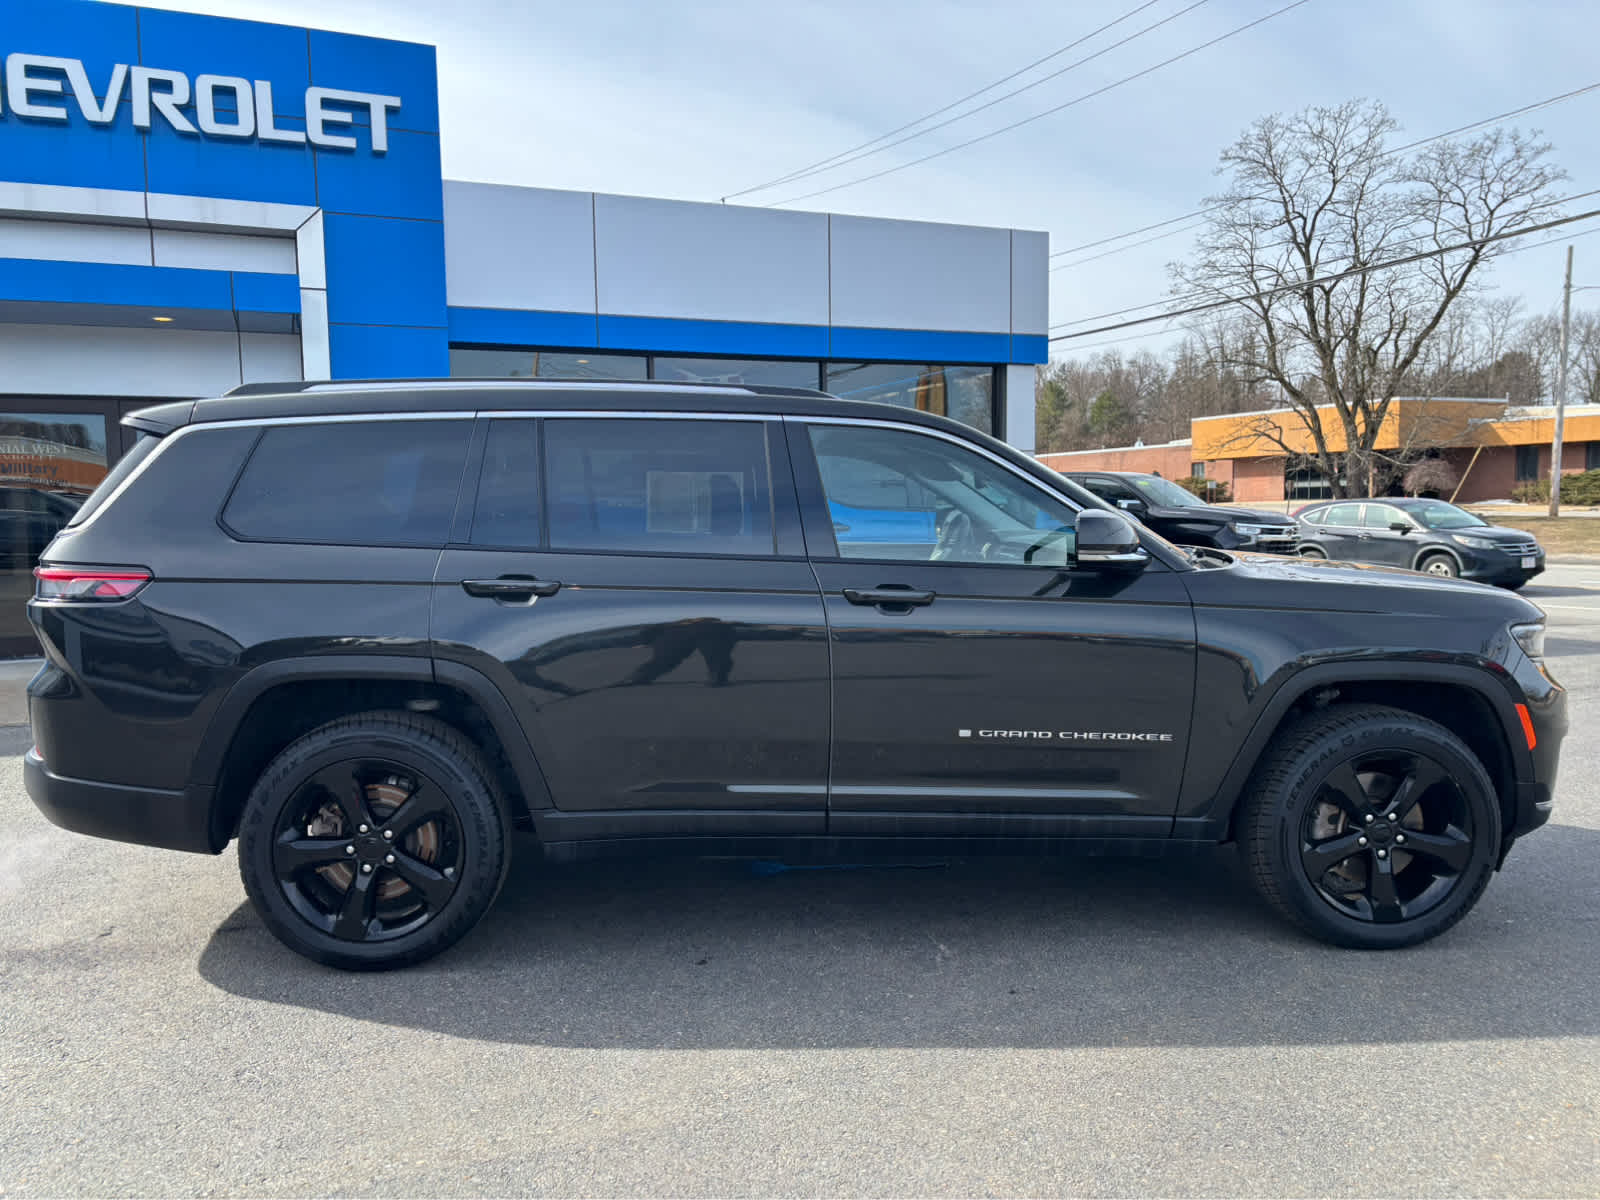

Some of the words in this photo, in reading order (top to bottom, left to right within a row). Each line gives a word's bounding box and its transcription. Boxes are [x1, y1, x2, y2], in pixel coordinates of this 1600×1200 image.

[0, 52, 401, 153] EVROLET
[978, 729, 1053, 739] GRAND
[1058, 731, 1174, 742] CHEROKEE
